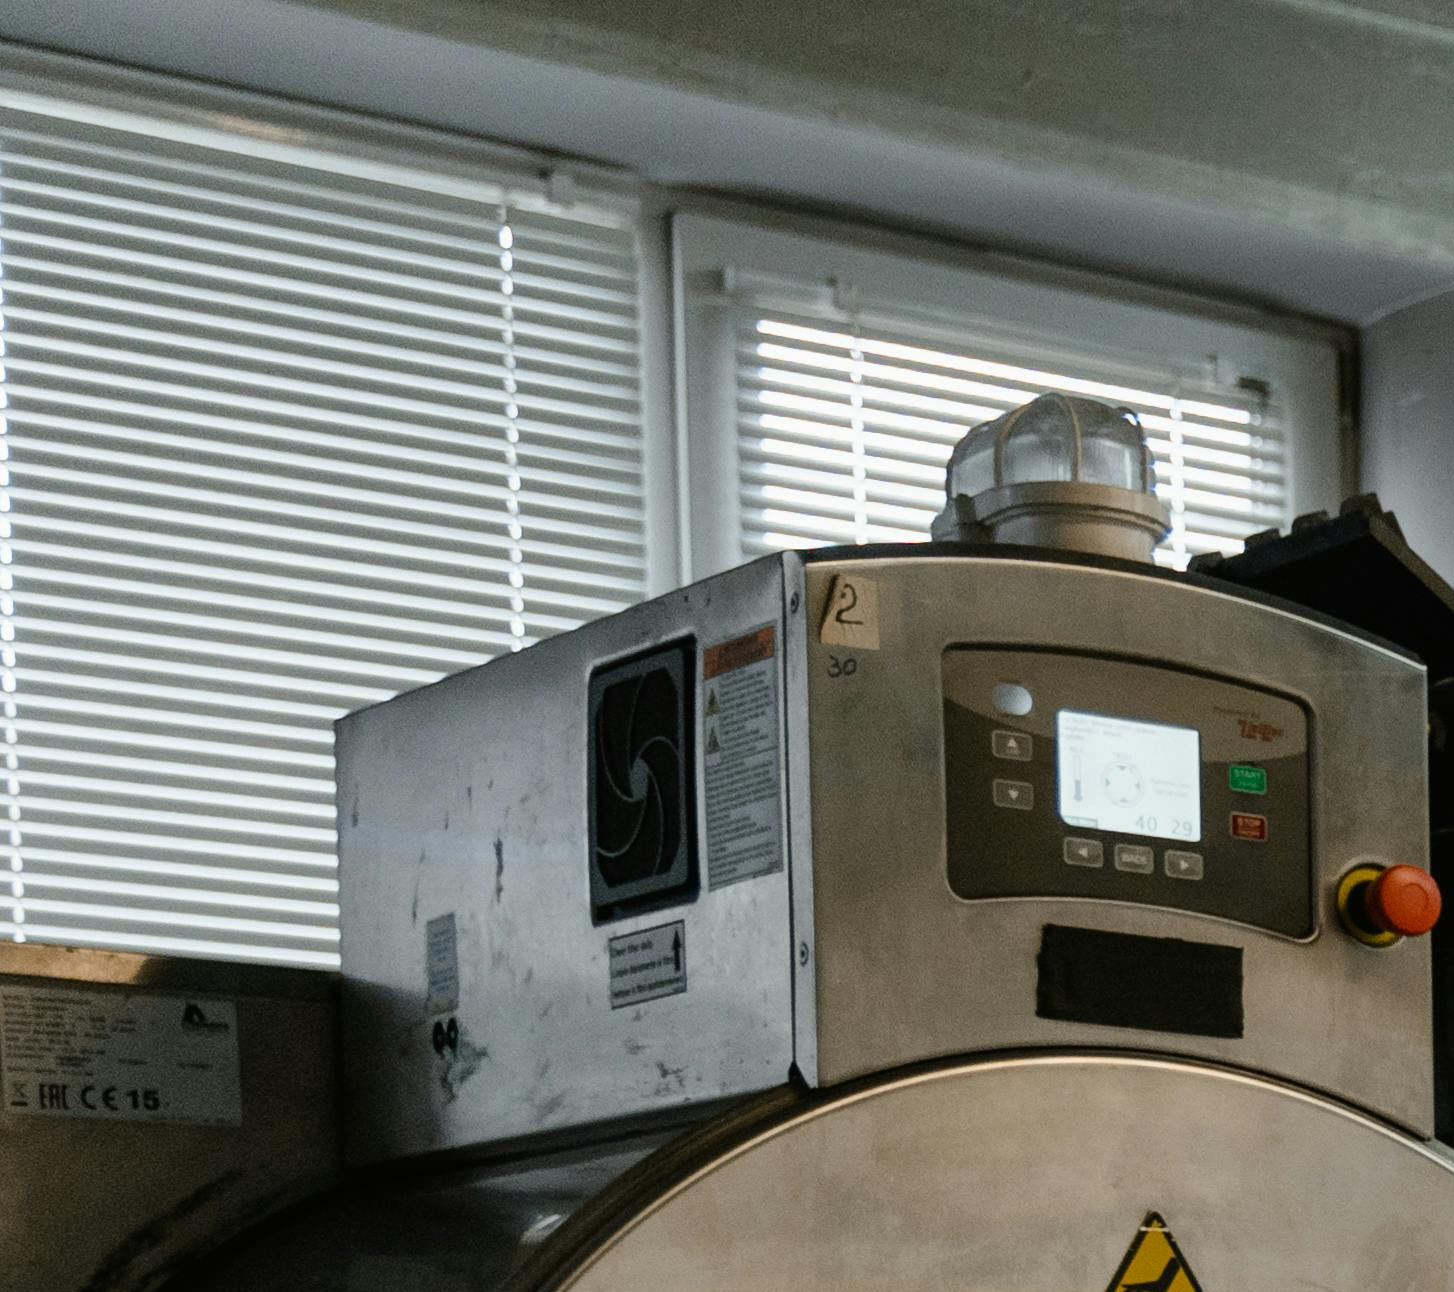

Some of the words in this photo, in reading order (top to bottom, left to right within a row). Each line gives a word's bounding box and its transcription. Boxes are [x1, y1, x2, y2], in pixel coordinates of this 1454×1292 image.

[836, 583, 864, 625] 2
[827, 654, 857, 678] 30
[1136, 815, 1158, 832] 40
[1171, 819, 1193, 837] 29
[1121, 852, 1147, 865] BACK
[126, 1088, 161, 1111] 15
